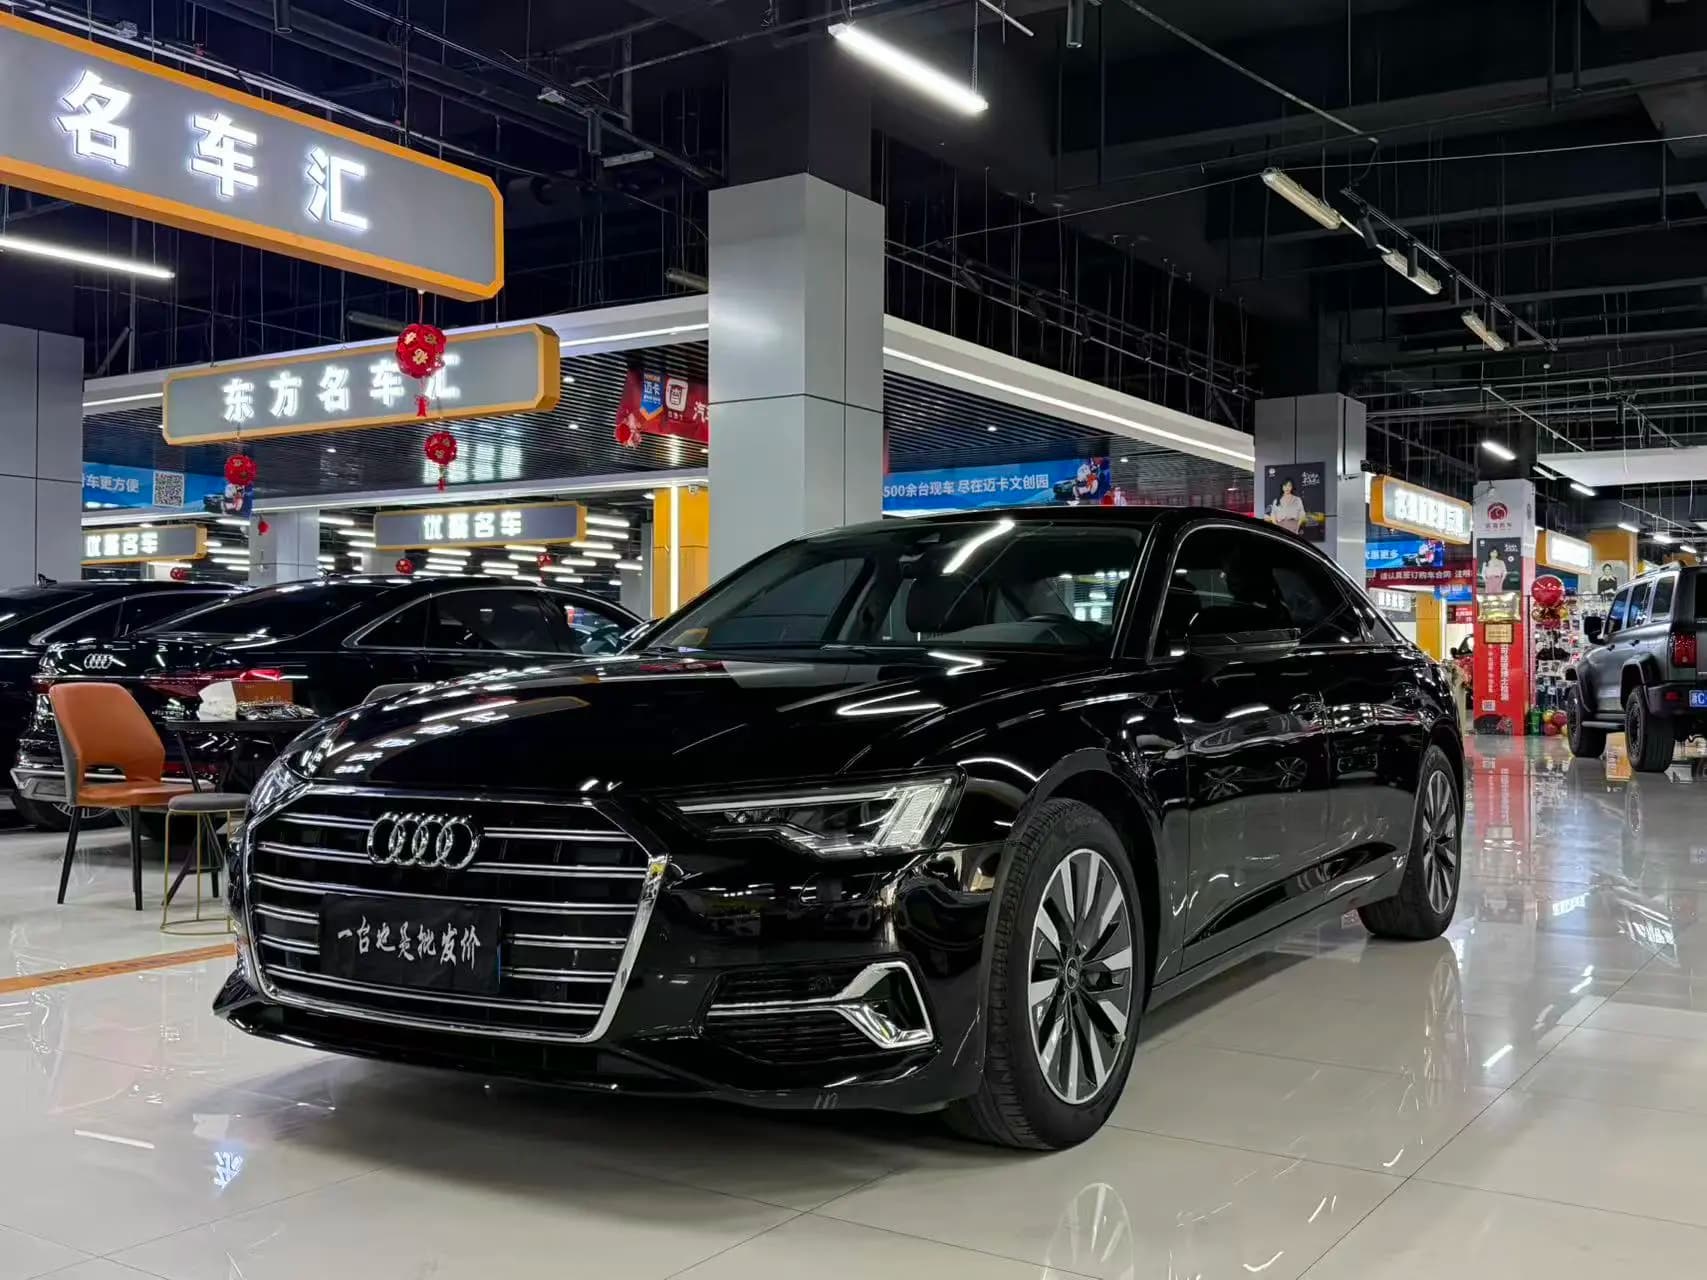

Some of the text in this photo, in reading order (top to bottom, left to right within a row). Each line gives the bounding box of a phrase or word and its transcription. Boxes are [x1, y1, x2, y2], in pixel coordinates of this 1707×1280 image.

[57, 69, 369, 231] 名车汇
[222, 353, 461, 424] 东方名车汇
[693, 401, 709, 423] 汽
[957, 473, 1049, 495] 尽在迈卡文创园
[337, 914, 481, 970] 一台也是批发价
